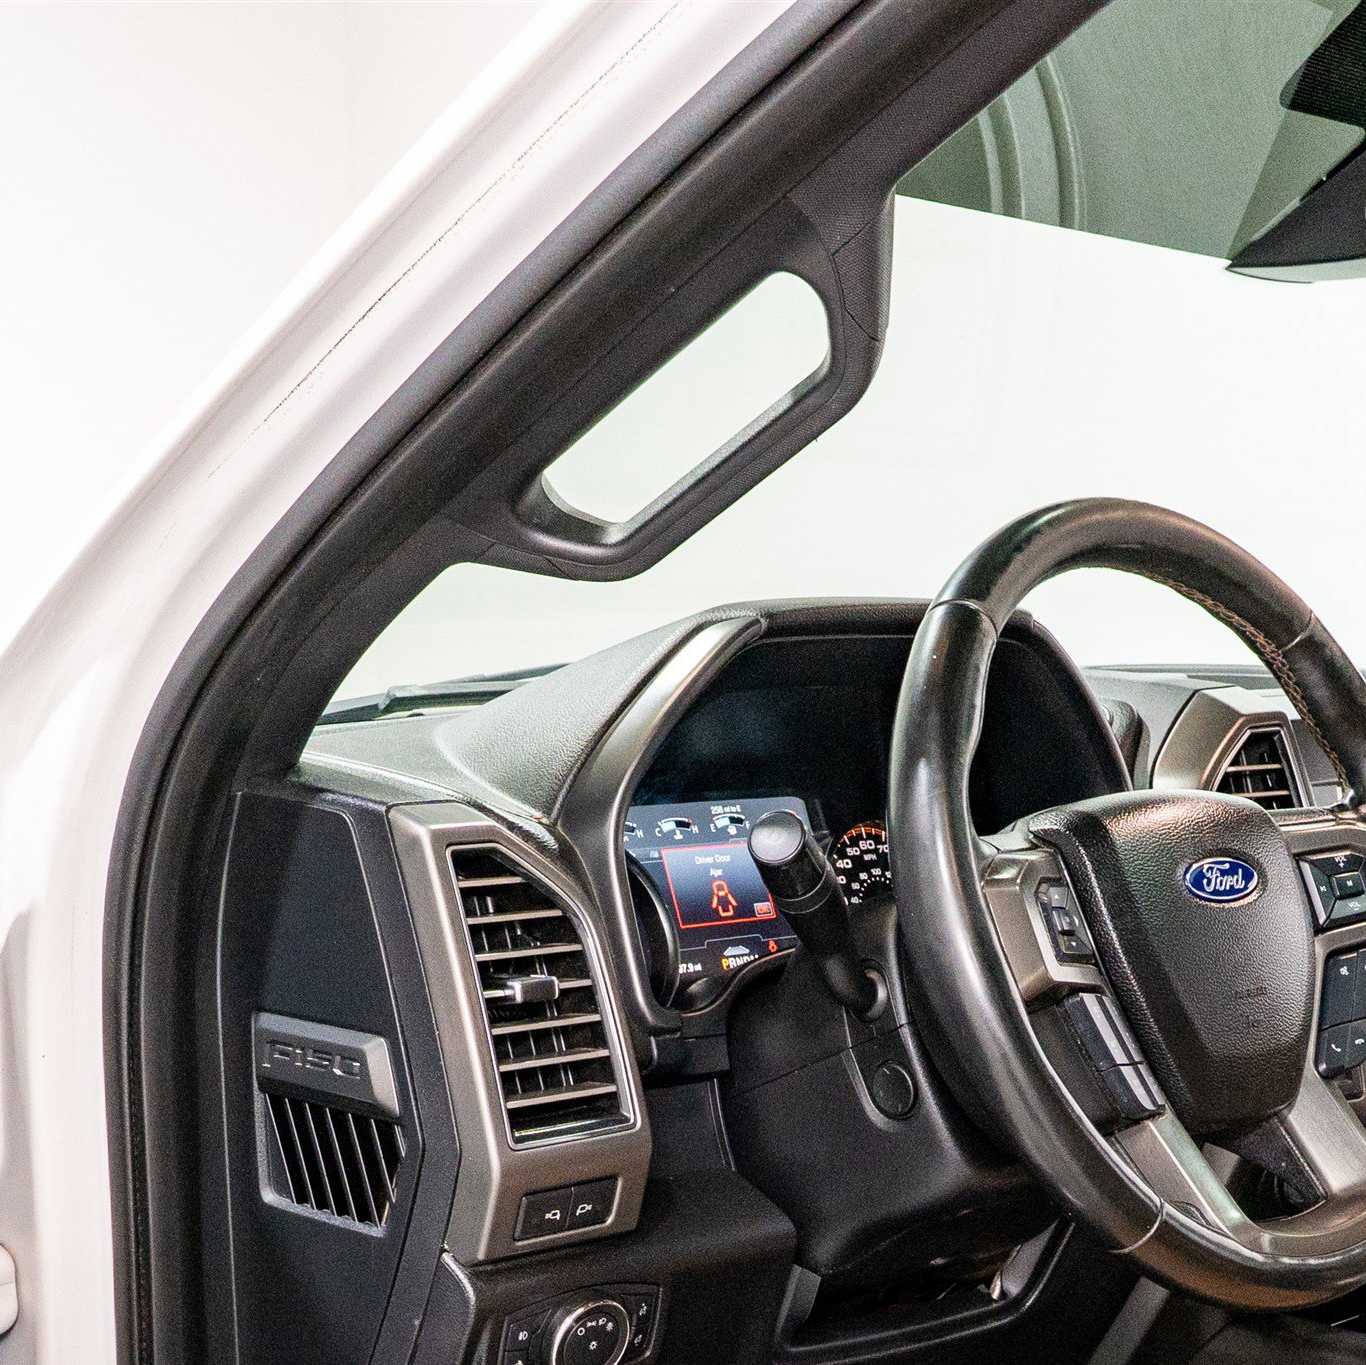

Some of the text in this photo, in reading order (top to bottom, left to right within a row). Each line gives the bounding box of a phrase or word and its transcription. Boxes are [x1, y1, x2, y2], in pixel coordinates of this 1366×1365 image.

[692, 826, 699, 834] H
[710, 823, 716, 832] E
[745, 821, 750, 830] F
[636, 829, 644, 838] H
[655, 827, 662, 837] C
[859, 840, 875, 850] 60
[876, 845, 889, 853] 70
[846, 847, 860, 856] 50
[695, 856, 714, 864] Driver
[836, 859, 852, 869] 40
[1202, 862, 1246, 893] Ford
[756, 904, 770, 914] OK
